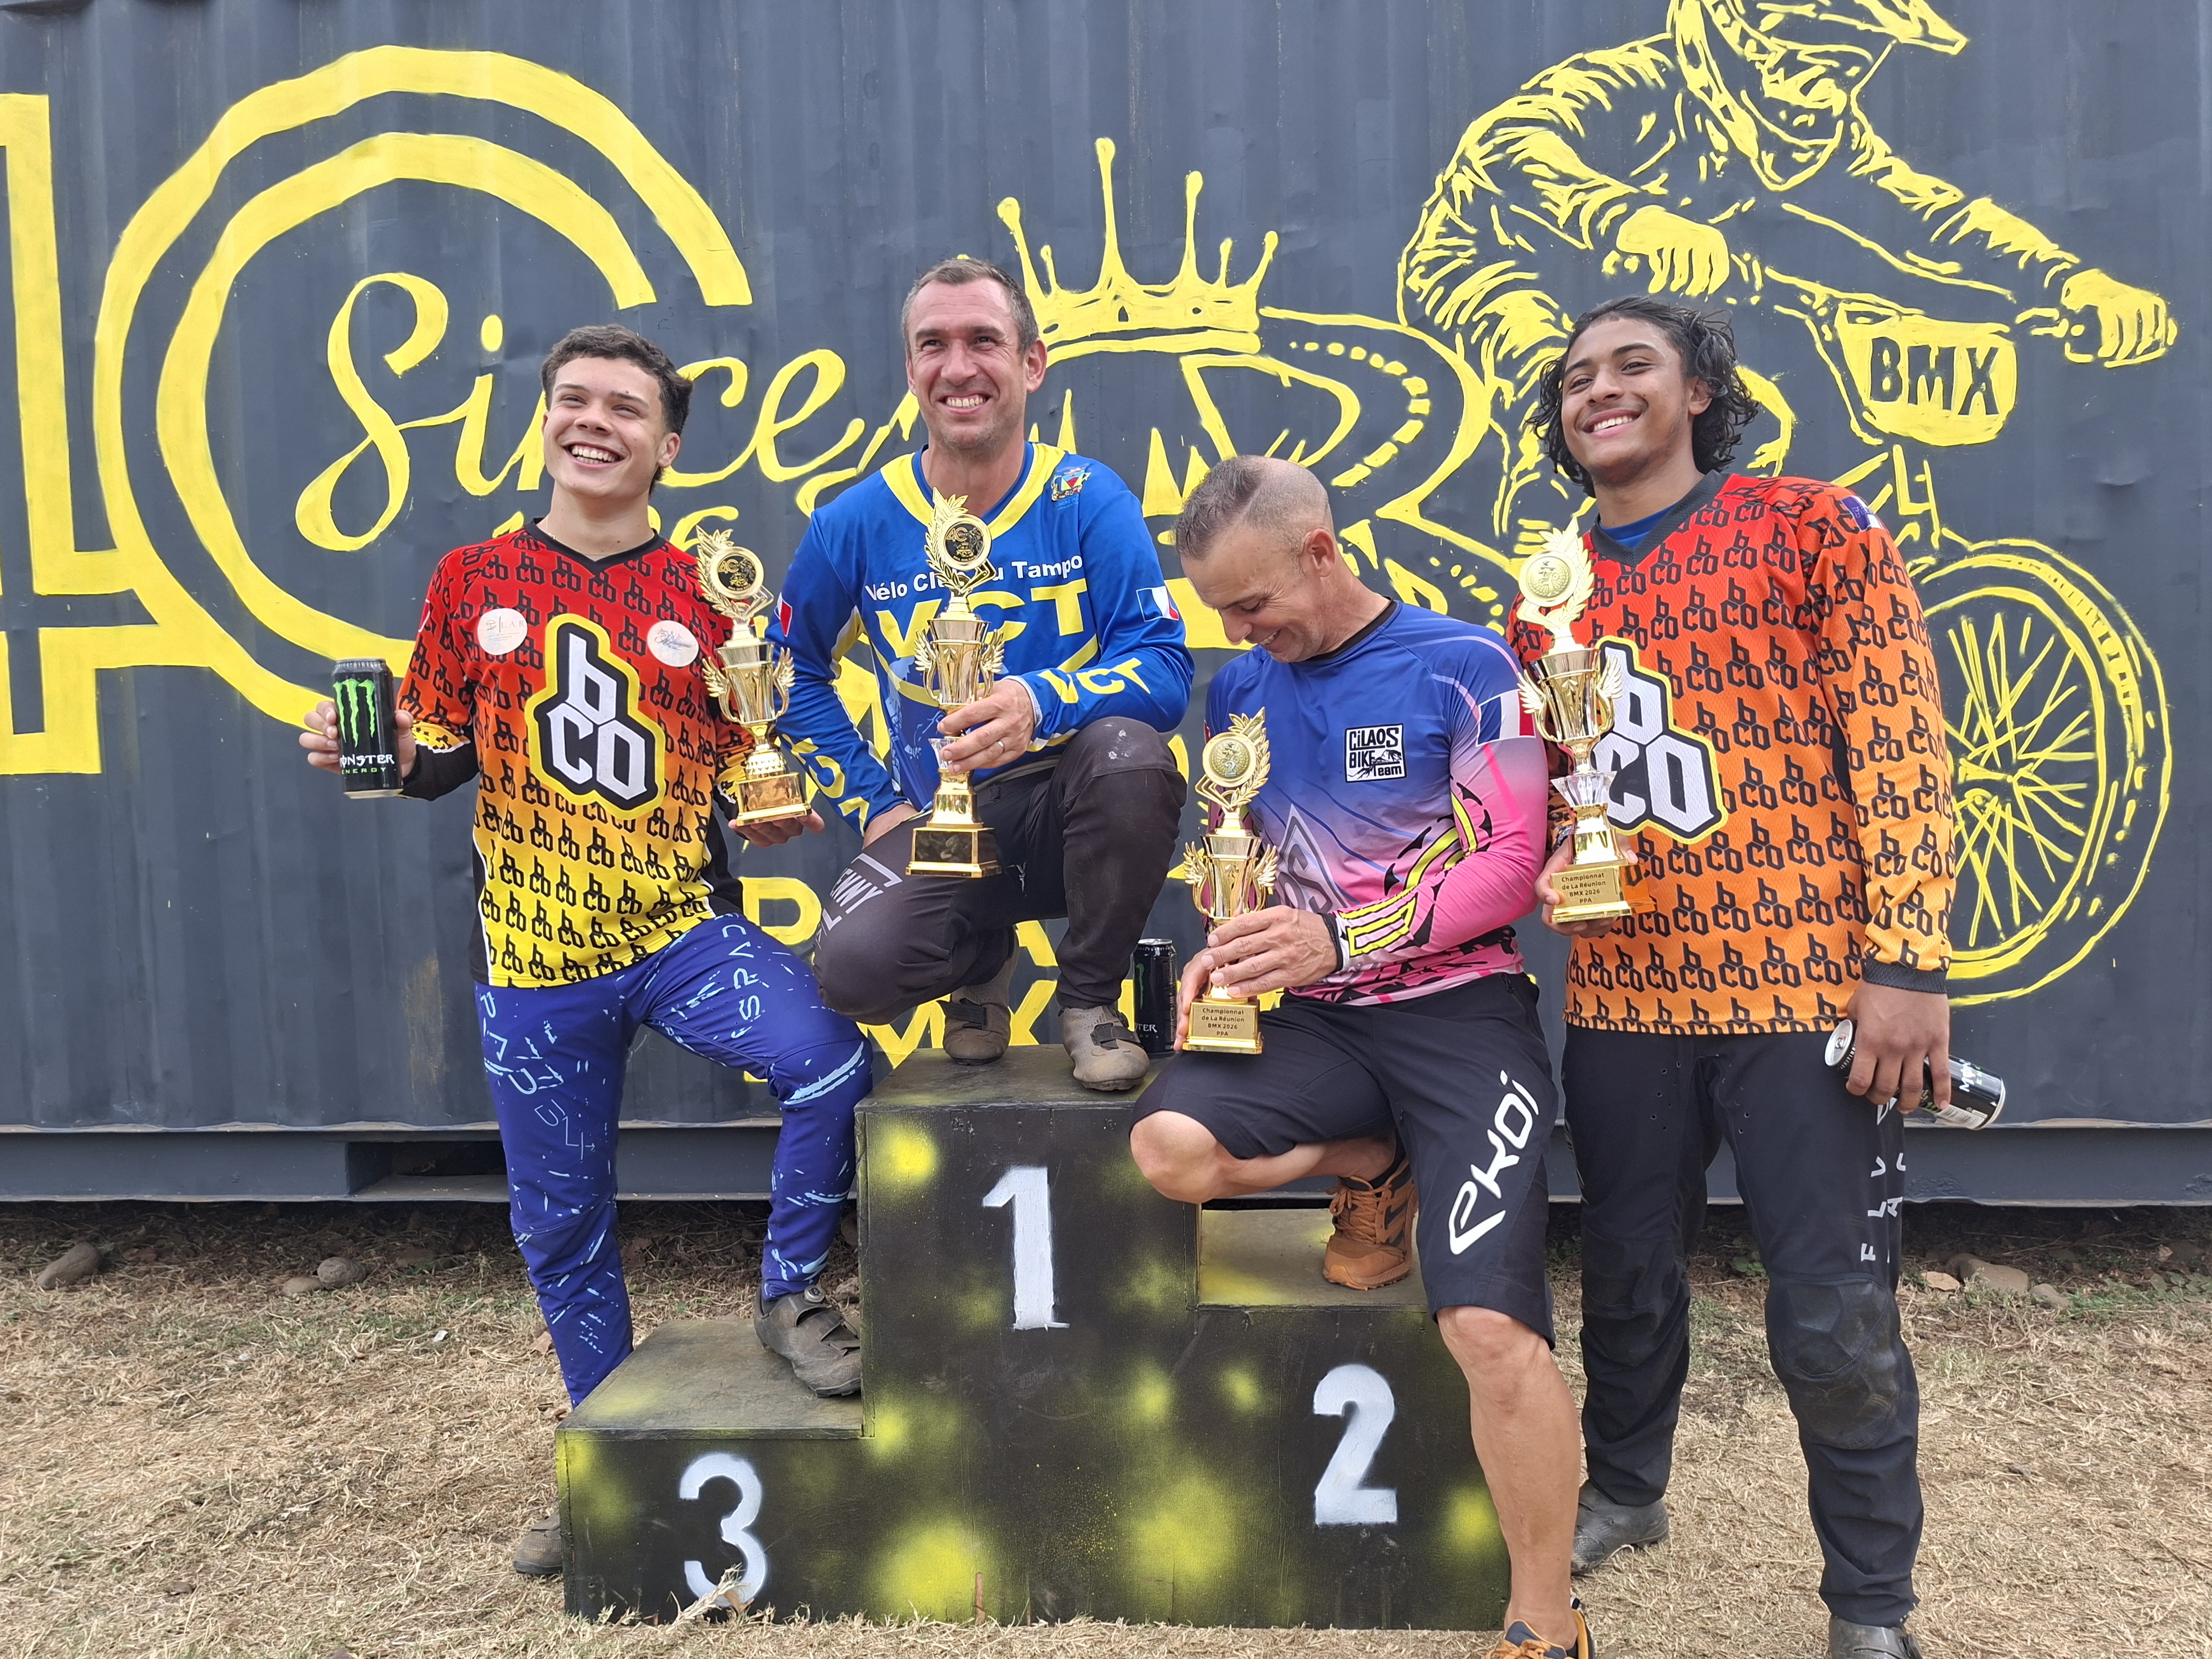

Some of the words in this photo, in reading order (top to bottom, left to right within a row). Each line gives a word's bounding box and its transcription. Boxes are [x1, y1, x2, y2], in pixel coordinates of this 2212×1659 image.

[1869, 336, 2000, 415] BMX
[865, 580, 908, 601] Vélo
[875, 578, 1087, 658] VCT
[1037, 658, 1151, 703] VCT
[1224, 760, 1238, 778] 2
[1349, 750, 1375, 768] BIKE
[1373, 764, 1402, 777] Team
[1561, 872, 1605, 883] Championnat
[981, 1165, 1071, 1330] 1
[1312, 1363, 1399, 1525] 2
[677, 1451, 769, 1608] 3
